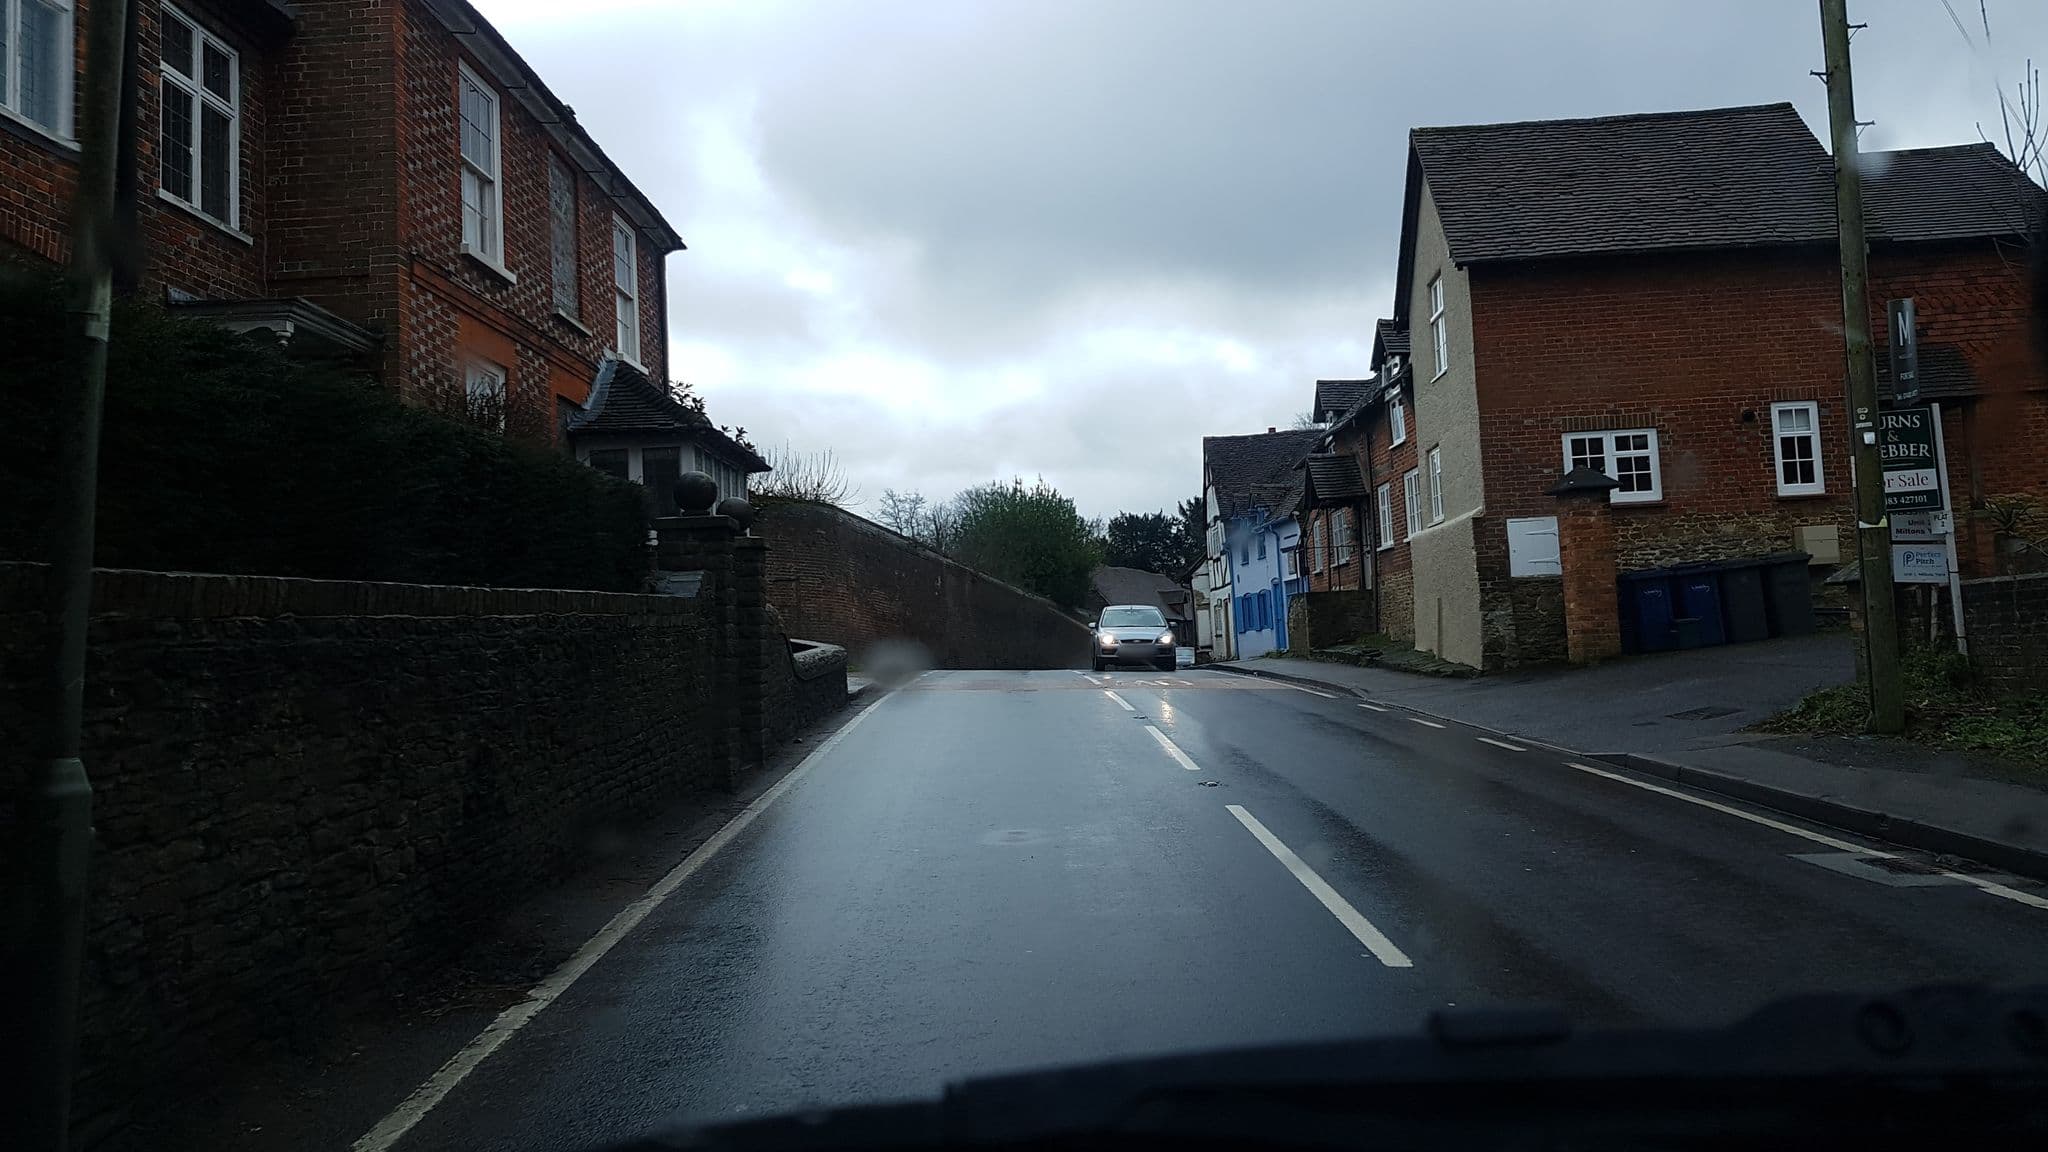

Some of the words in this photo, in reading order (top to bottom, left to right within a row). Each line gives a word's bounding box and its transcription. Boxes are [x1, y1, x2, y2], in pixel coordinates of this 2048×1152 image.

[1880, 415, 1921, 429] URNS
[1887, 430, 1901, 442] &
[1881, 443, 1931, 458] EBBER
[1898, 473, 1929, 487] Sale
[1900, 495, 1928, 504] 427101
